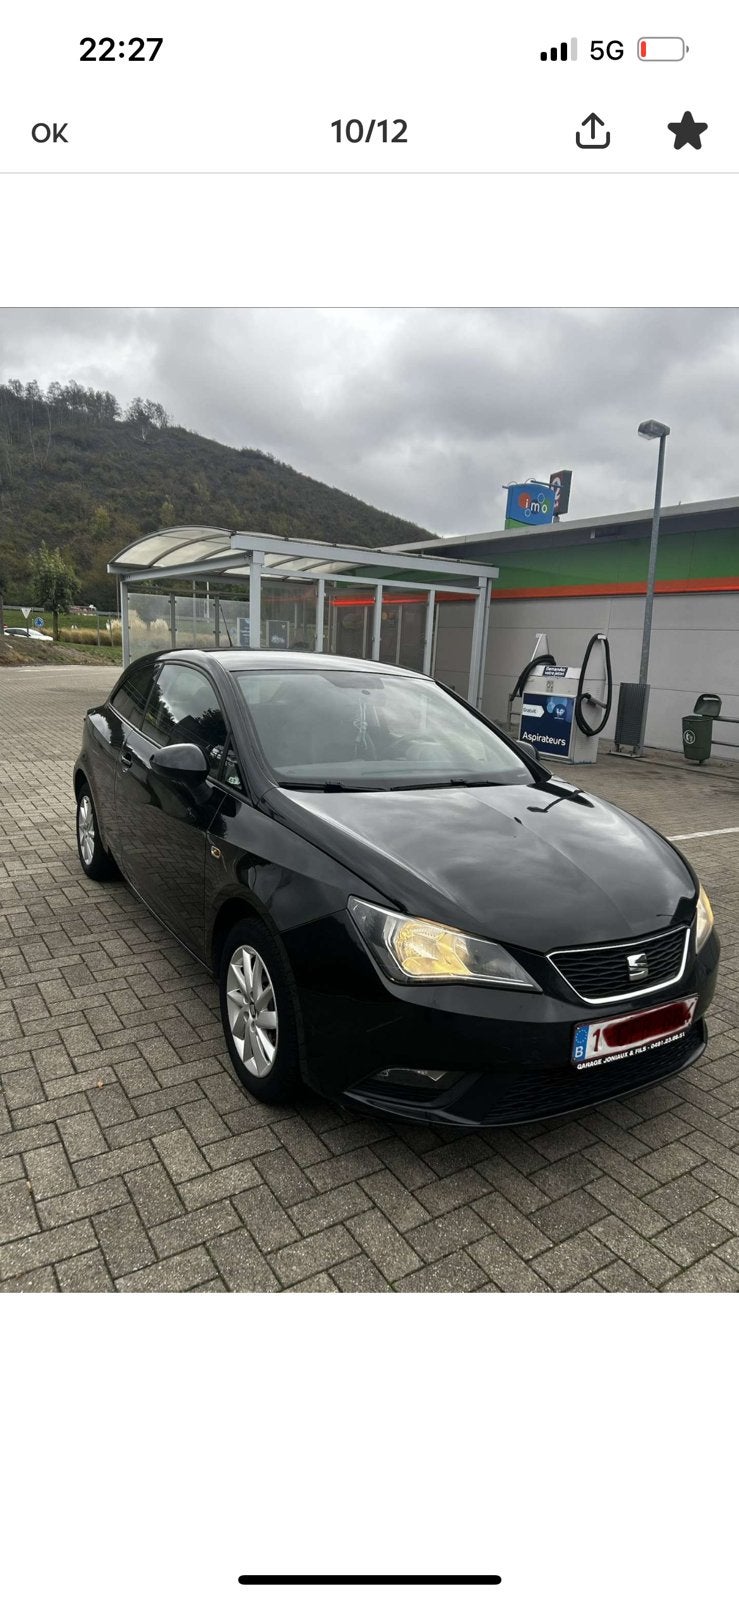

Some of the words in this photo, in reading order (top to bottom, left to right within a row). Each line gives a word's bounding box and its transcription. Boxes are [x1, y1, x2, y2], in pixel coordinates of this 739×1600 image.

[522, 731, 567, 746] Aspirateurs
[576, 1058, 602, 1070] GARAGE
[602, 1051, 628, 1064] JONIAUX
[635, 1046, 647, 1055] FILS
